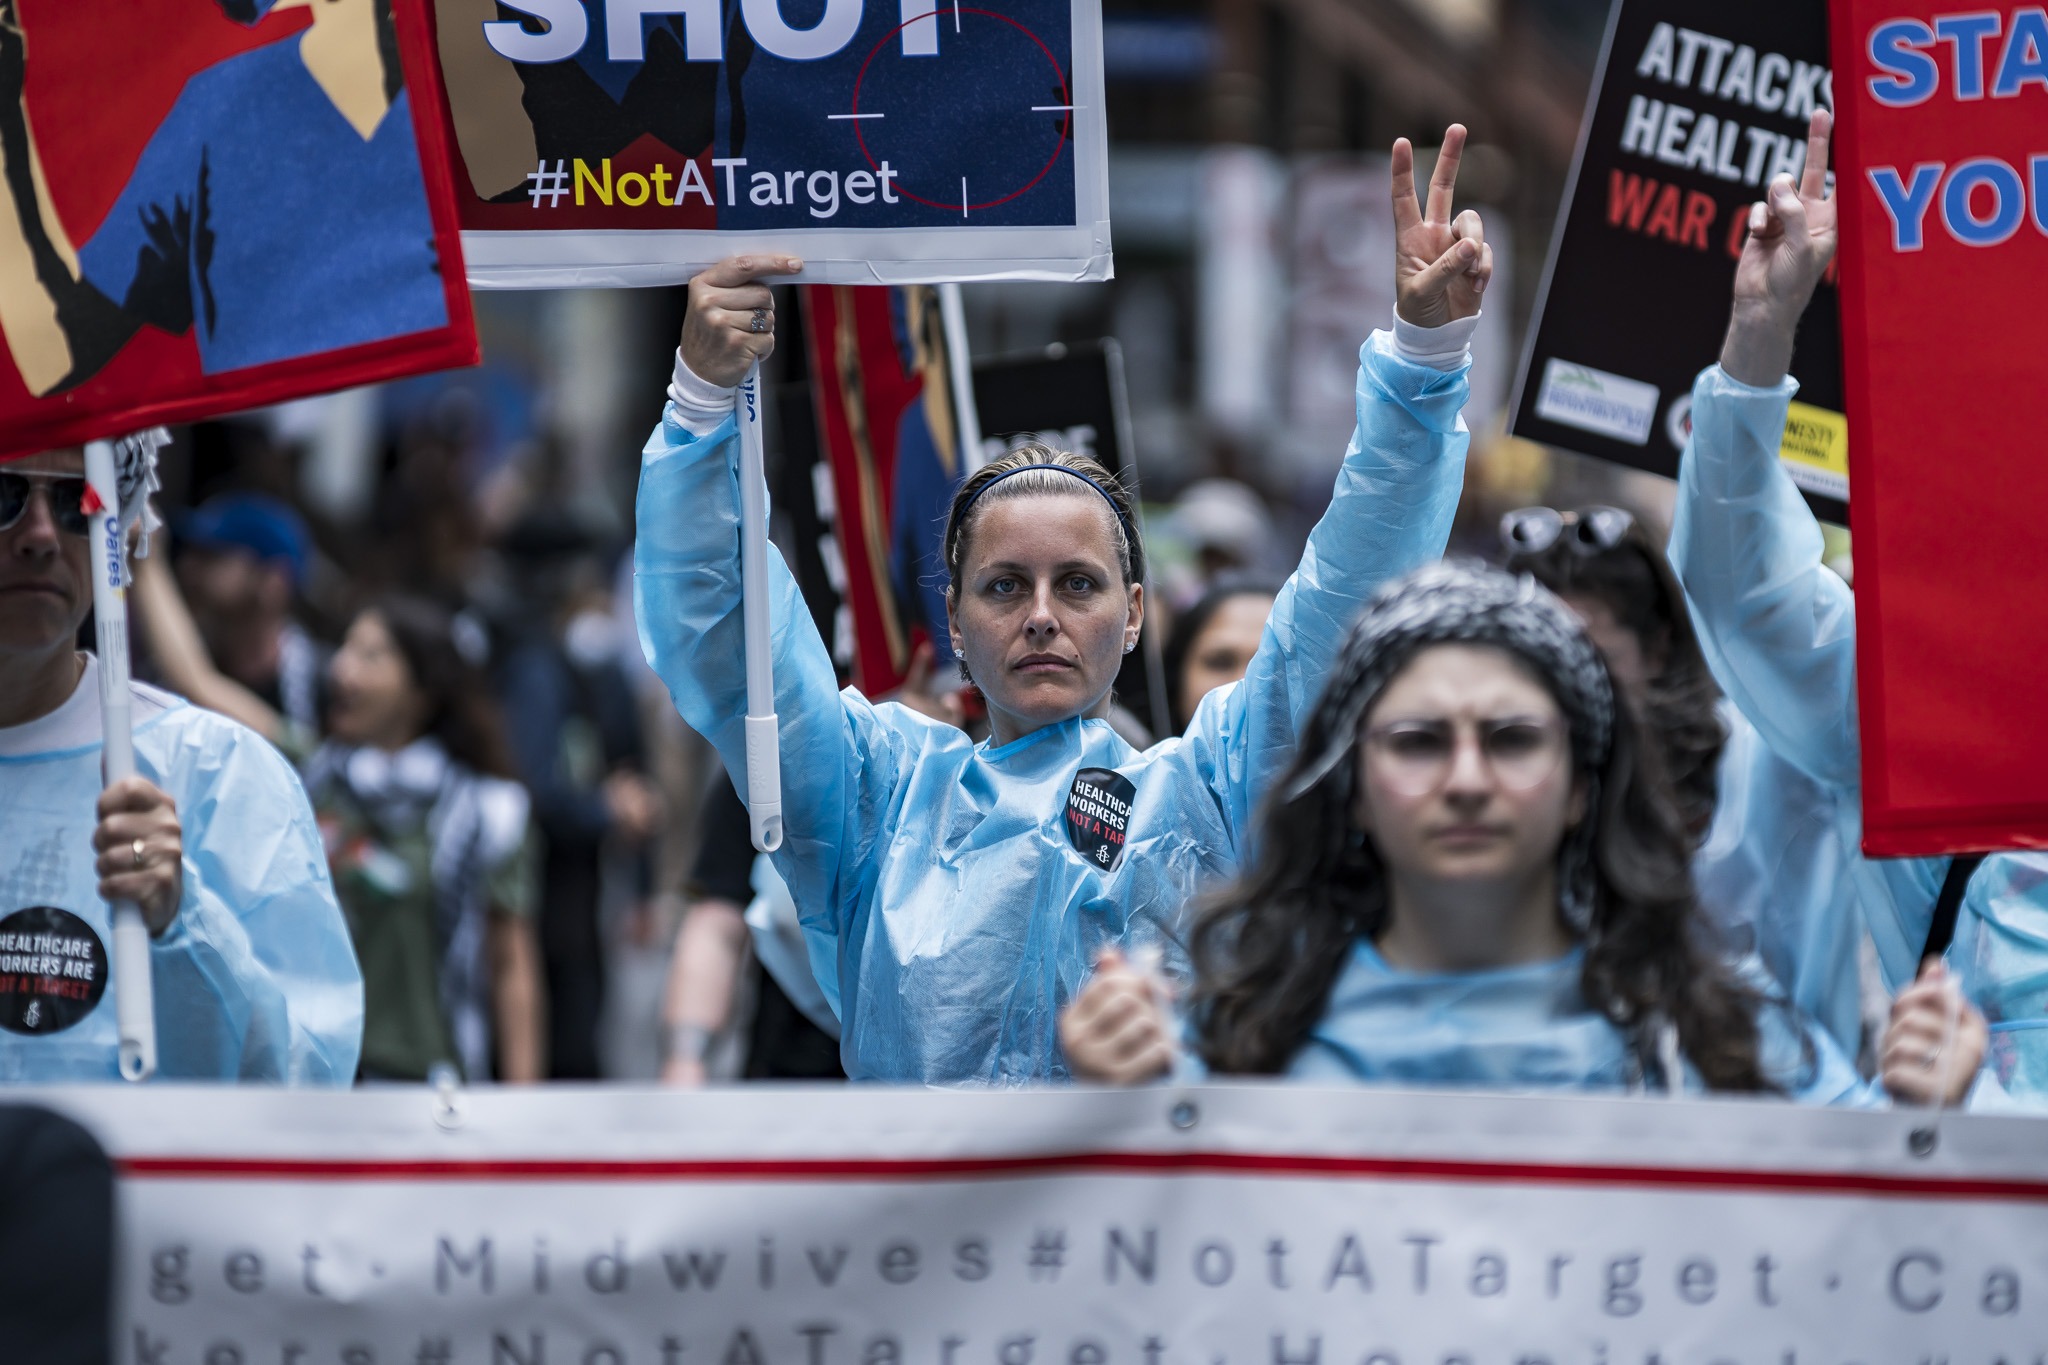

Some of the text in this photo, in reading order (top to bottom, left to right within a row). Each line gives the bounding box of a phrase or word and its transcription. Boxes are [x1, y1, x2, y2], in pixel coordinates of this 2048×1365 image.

[1620, 94, 1836, 198] HEALTH
[526, 157, 898, 218] #NotATarget
[1608, 168, 1718, 251] WAR
[1865, 154, 2048, 252] YO
[1069, 808, 1091, 829] NOT
[1093, 821, 1101, 835] A
[1070, 792, 1125, 830] WORKERS
[0, 954, 95, 980] ORKERS ARE
[18, 976, 30, 993] A
[34, 977, 90, 1000] TARGET
[434, 1228, 1778, 1317] Midwives#NotATarget
